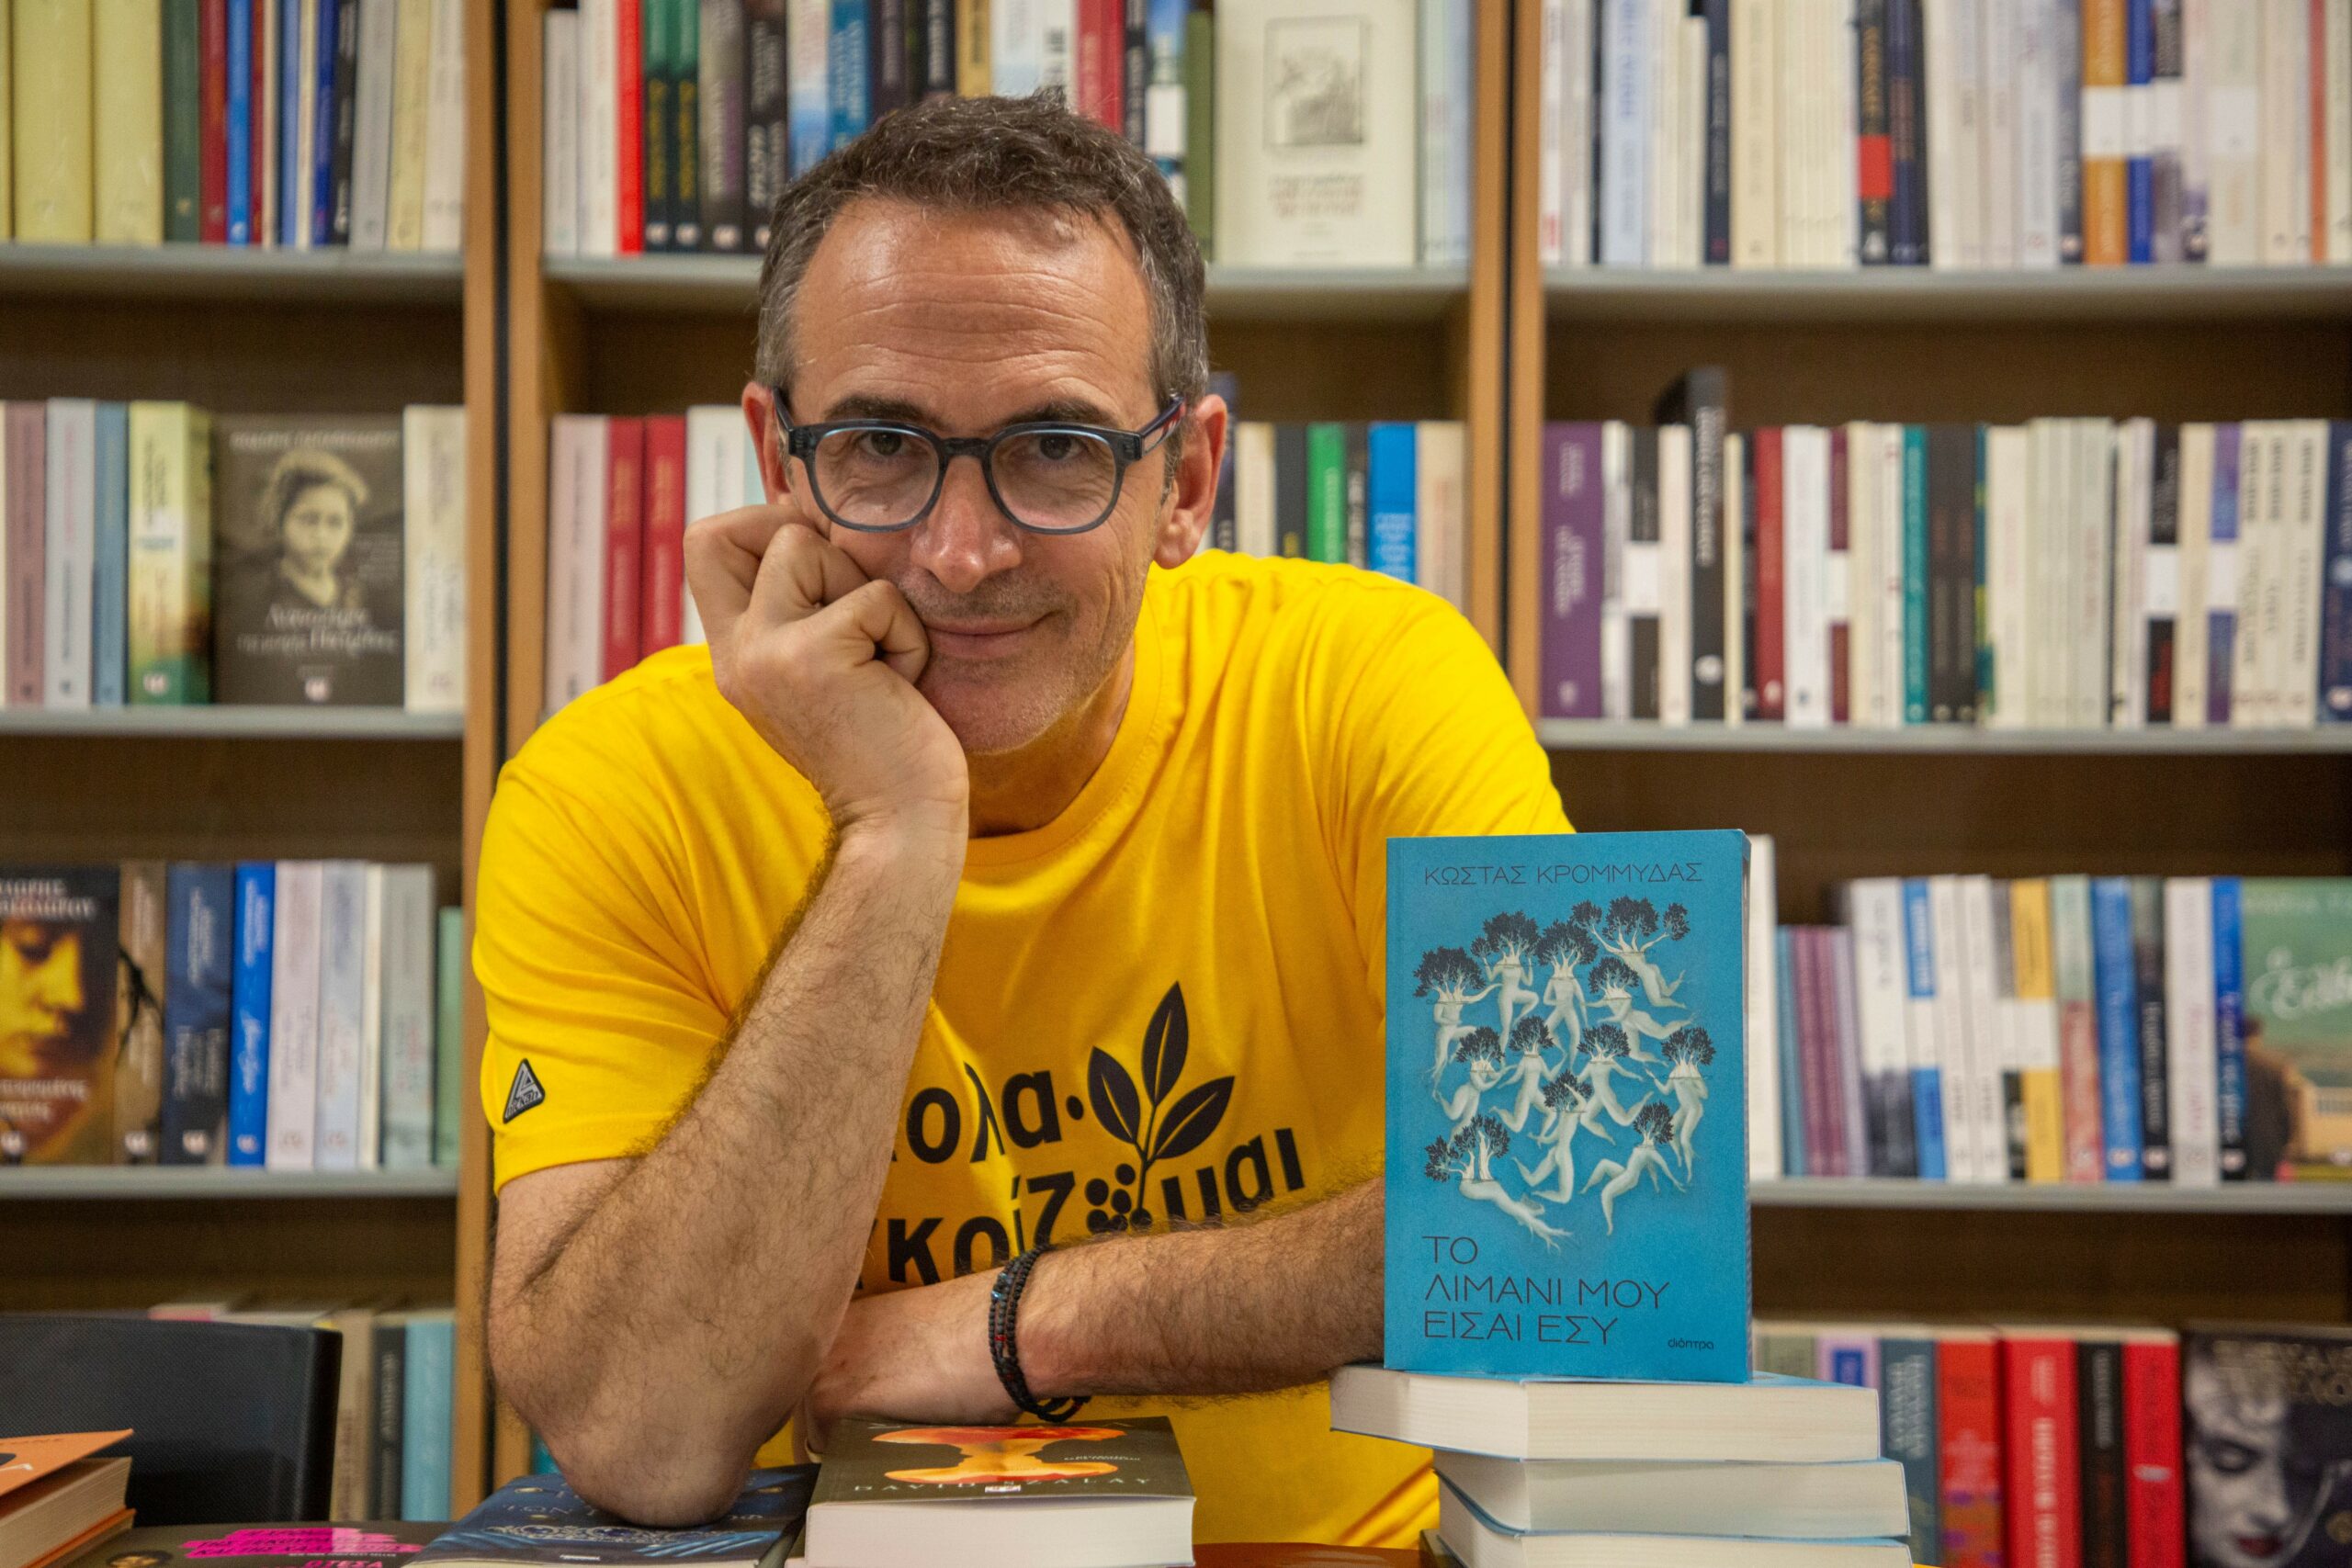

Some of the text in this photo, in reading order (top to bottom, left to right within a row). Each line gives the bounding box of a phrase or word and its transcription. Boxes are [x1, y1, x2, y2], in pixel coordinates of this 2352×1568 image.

[1424, 862, 1704, 886] ΚΩΣΤΑΣ ΚΡΟΜΜΥΔΑΣ
[1421, 1235, 1479, 1265] ΤΟ
[1425, 1273, 1670, 1309] ΛΙΜΑΝΙ ΜΟΥ
[1424, 1310, 1618, 1346] ΕΙΣΑΙ ΕΣΥ
